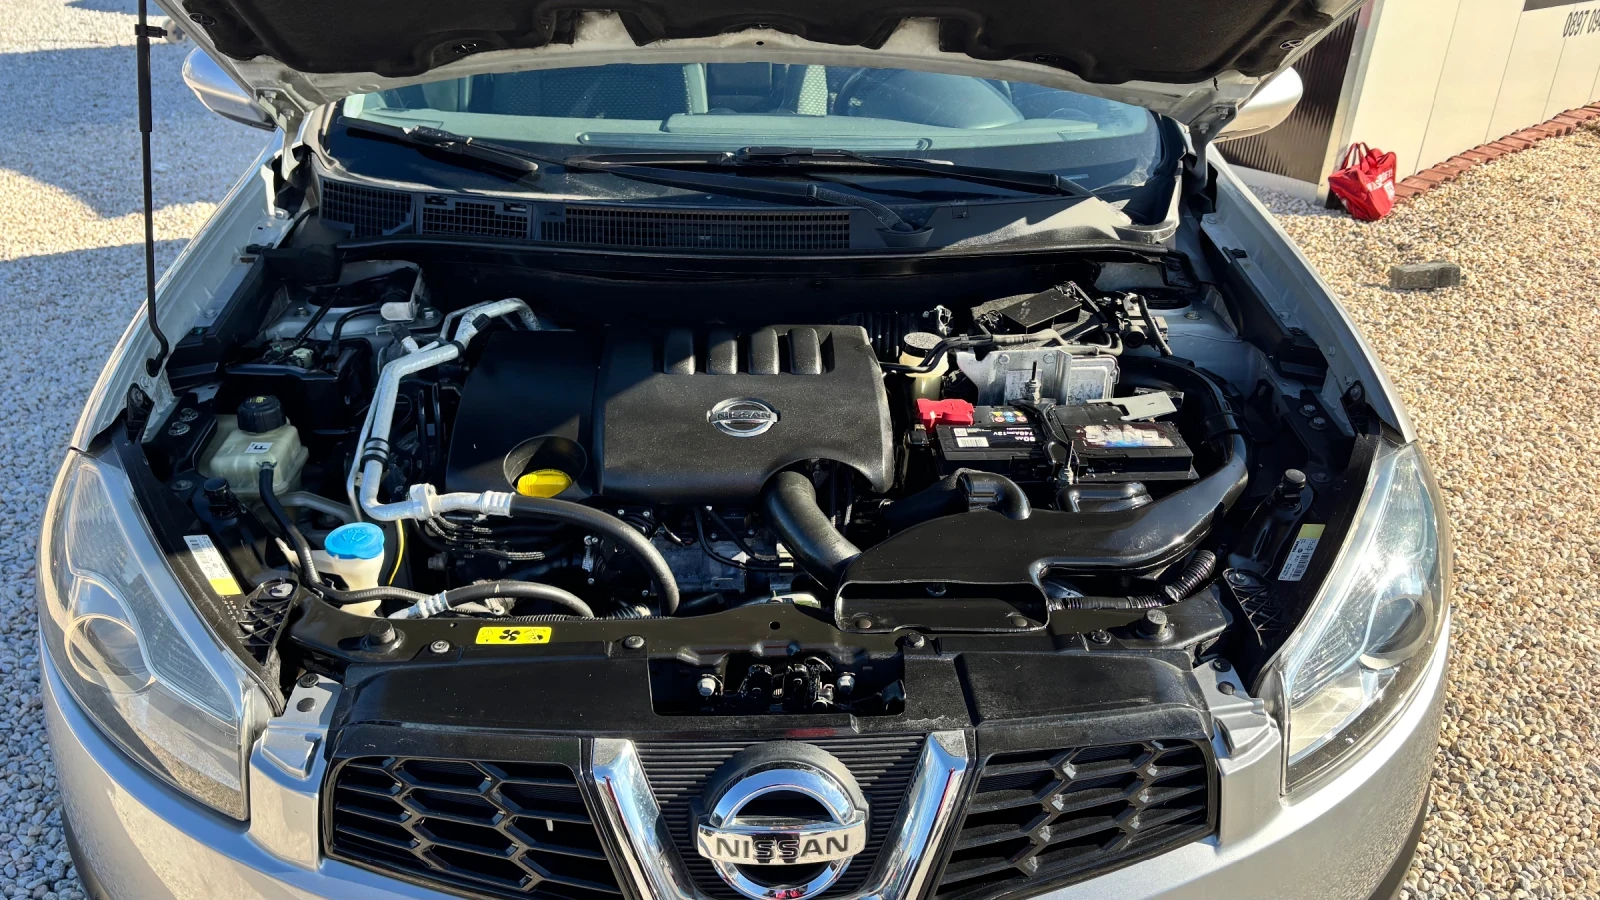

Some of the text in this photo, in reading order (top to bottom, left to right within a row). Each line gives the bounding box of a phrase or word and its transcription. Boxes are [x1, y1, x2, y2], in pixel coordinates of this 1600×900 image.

[1562, 10, 1590, 38] 0897
[717, 411, 772, 420] NISSAN
[716, 834, 849, 860] NISSAN
